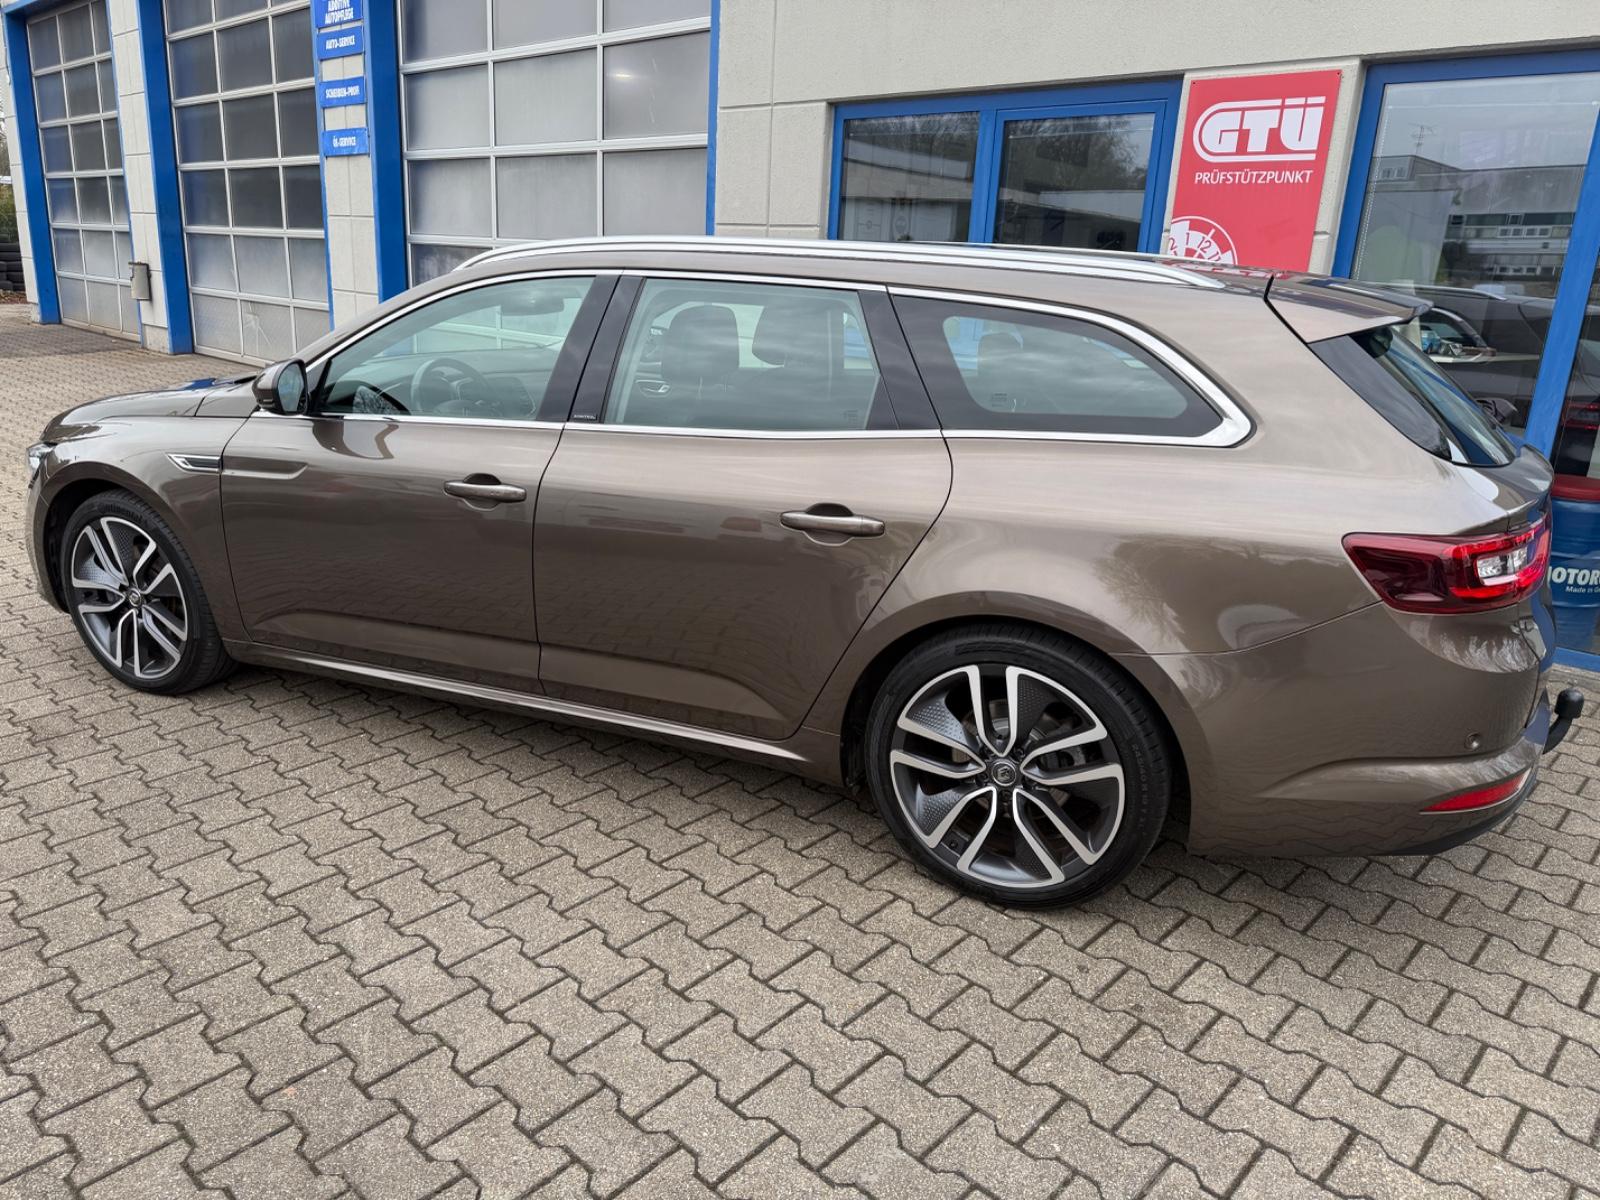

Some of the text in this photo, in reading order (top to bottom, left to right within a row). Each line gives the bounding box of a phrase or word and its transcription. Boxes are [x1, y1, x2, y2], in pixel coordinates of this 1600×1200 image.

[325, 35, 356, 50] AUTO-SERVICE
[1199, 96, 1326, 154] GTÜ
[1194, 169, 1313, 185] PRÜFSTÜTZPUNKT
[1197, 236, 1212, 254] 12
[1547, 565, 1600, 588] OTOR
